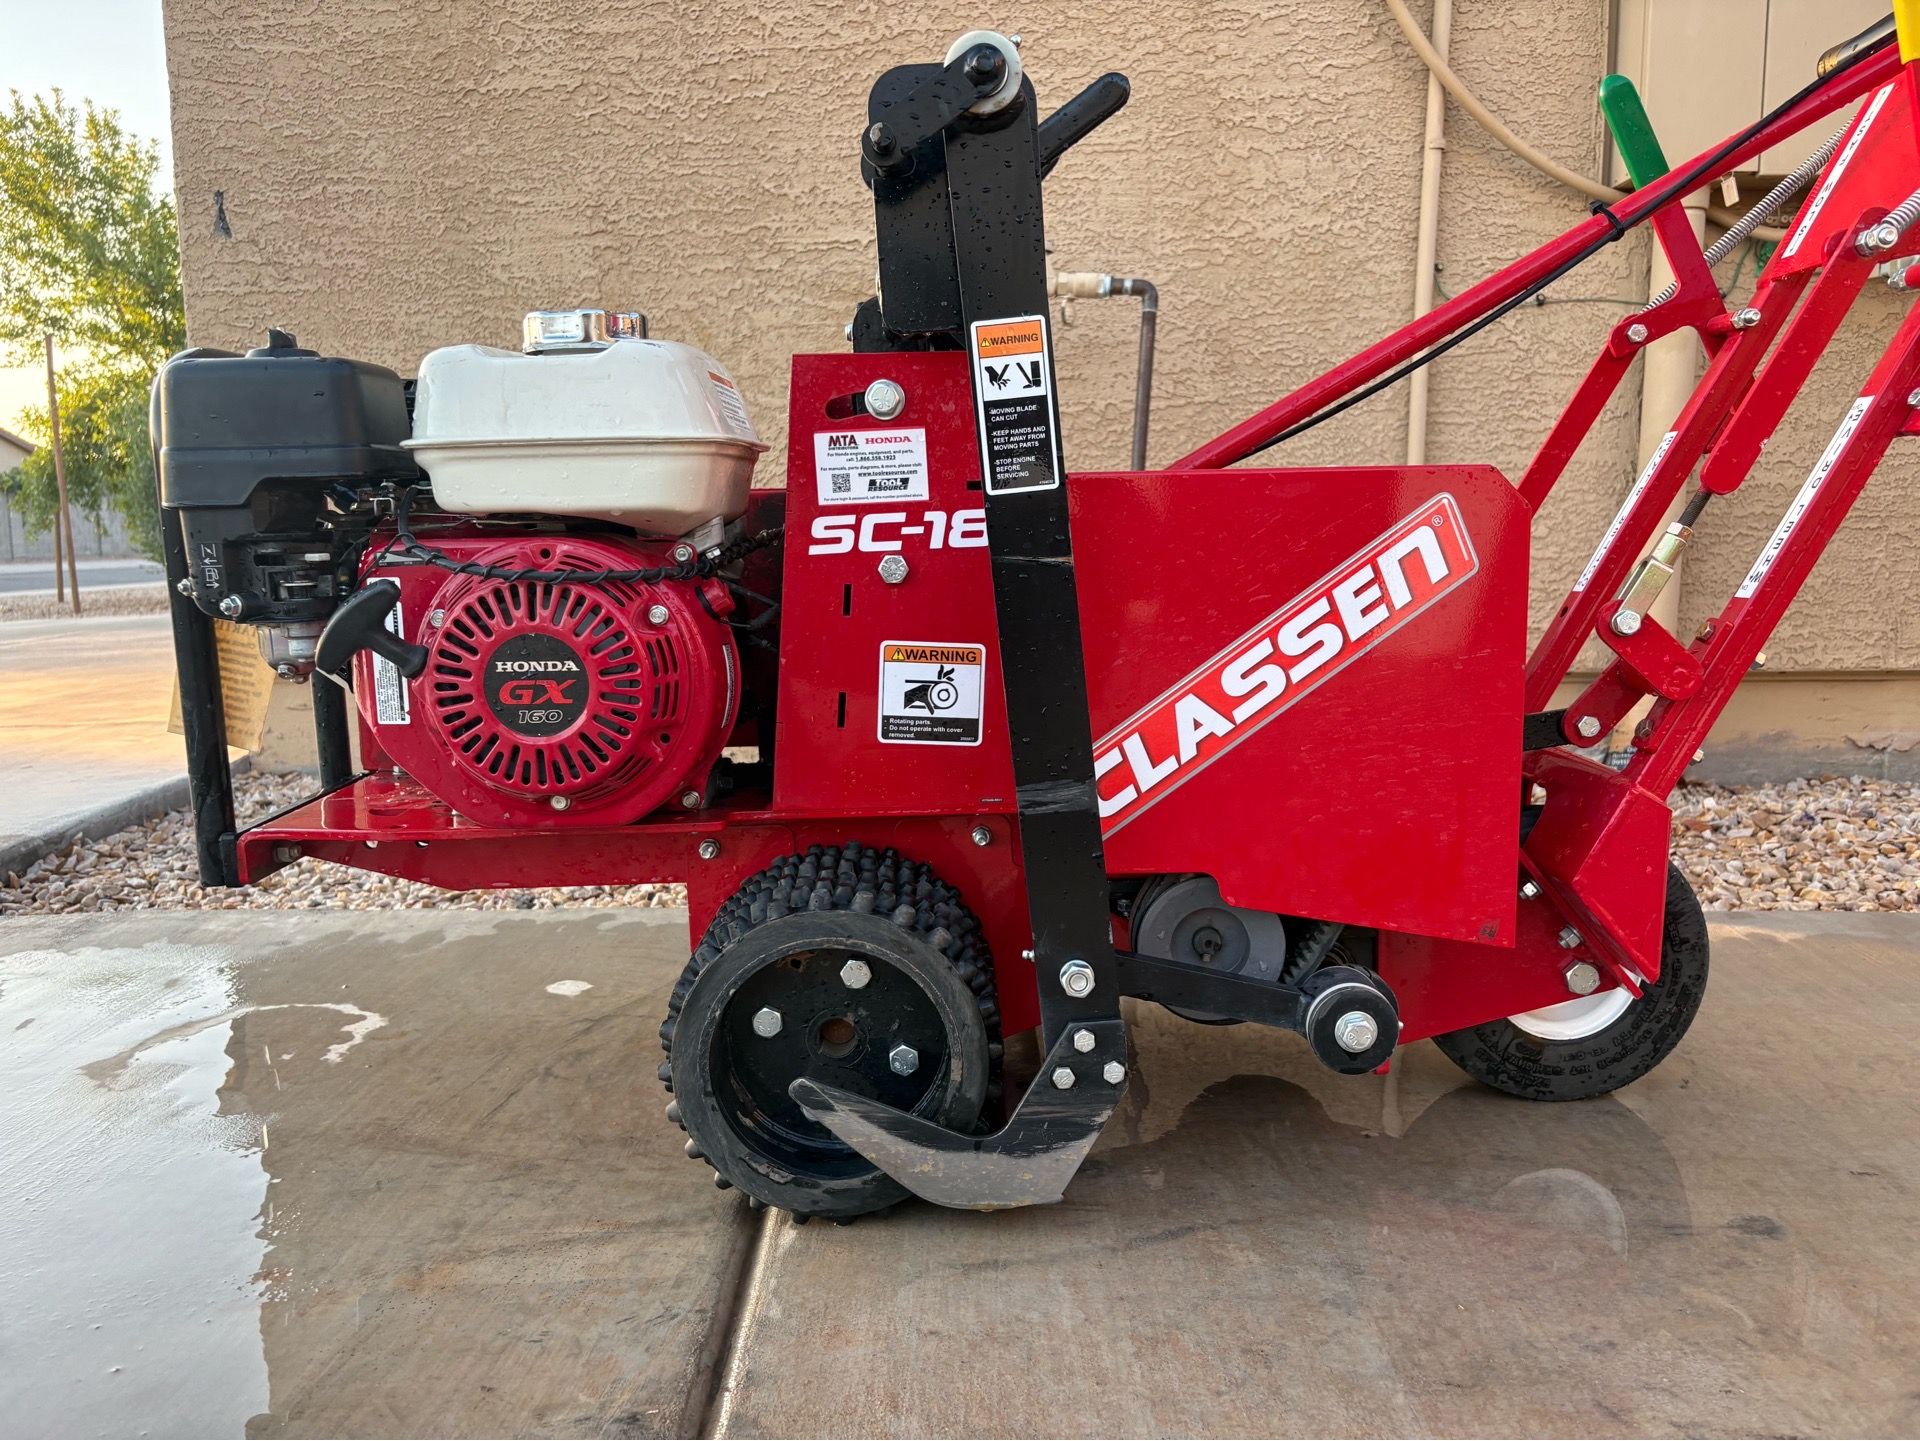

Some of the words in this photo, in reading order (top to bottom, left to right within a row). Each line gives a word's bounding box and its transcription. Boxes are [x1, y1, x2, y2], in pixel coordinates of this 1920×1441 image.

[990, 332, 1039, 346] WARNING
[1016, 404, 1037, 413] BLADE
[990, 414, 1005, 422] CAN
[1005, 413, 1019, 421] CUT
[1010, 427, 1032, 435] HANDS
[1032, 425, 1046, 433] AND
[828, 434, 858, 447] MTA
[865, 436, 912, 445] HONDA
[993, 436, 1009, 444] FEET
[1009, 434, 1027, 442] AWAY
[1027, 432, 1046, 440] FROM
[994, 442, 1018, 451] MOVING
[1018, 440, 1039, 449] PARTS
[1013, 455, 1036, 464] ENGINE
[996, 464, 1021, 473] BEFORE
[996, 471, 1030, 480] SERVICING
[875, 478, 903, 486] TOOL
[867, 484, 908, 492] RESOURCE
[1749, 504, 1805, 583] WHEEL
[1811, 409, 1864, 489] DRIVE
[808, 508, 989, 556] SC-18
[904, 648, 977, 662] WARNING
[495, 660, 580, 673] HONDA
[498, 679, 577, 705] GX
[518, 709, 563, 724] 160
